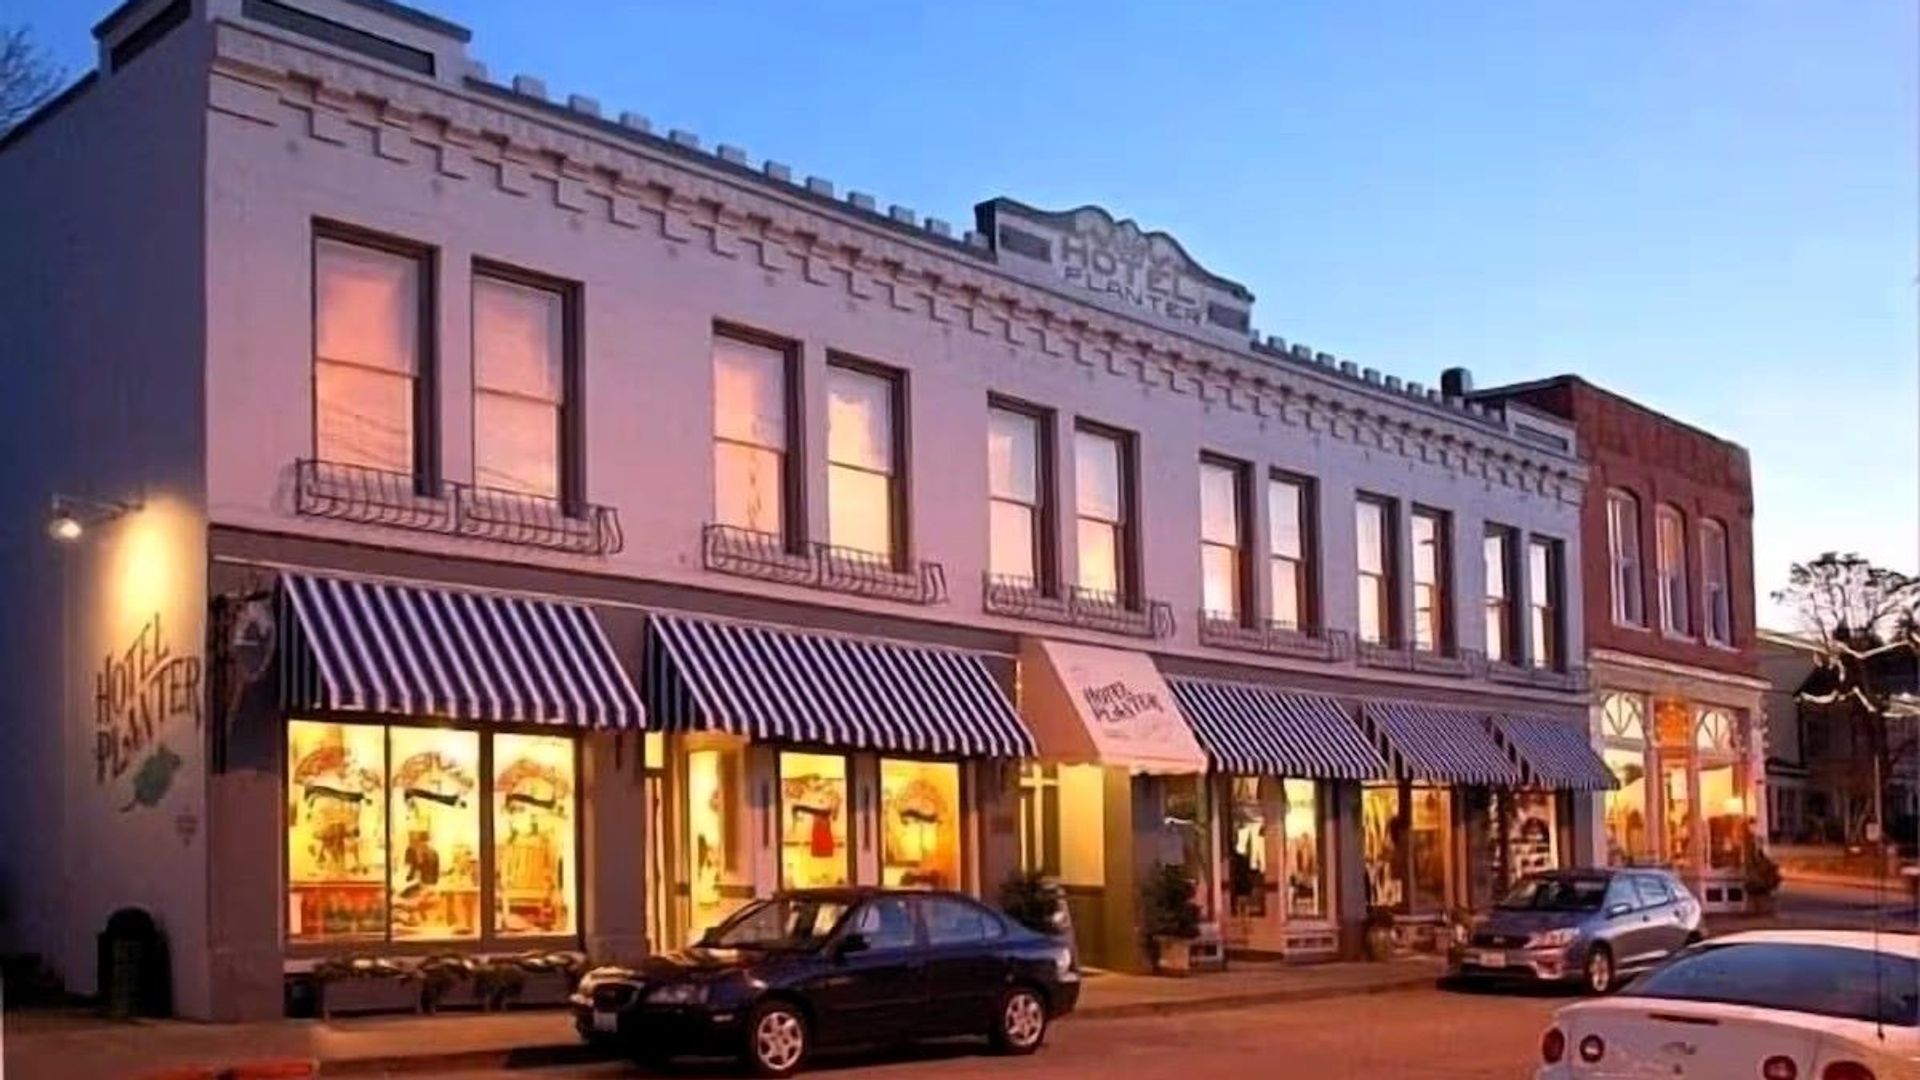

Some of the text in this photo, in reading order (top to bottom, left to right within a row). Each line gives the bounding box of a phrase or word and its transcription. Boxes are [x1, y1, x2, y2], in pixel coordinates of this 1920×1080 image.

[1061, 238, 1196, 304] HOTEL
[1065, 267, 1202, 324] PLANTER
[96, 612, 170, 722] HOTEL
[95, 656, 200, 786] PLANTER
